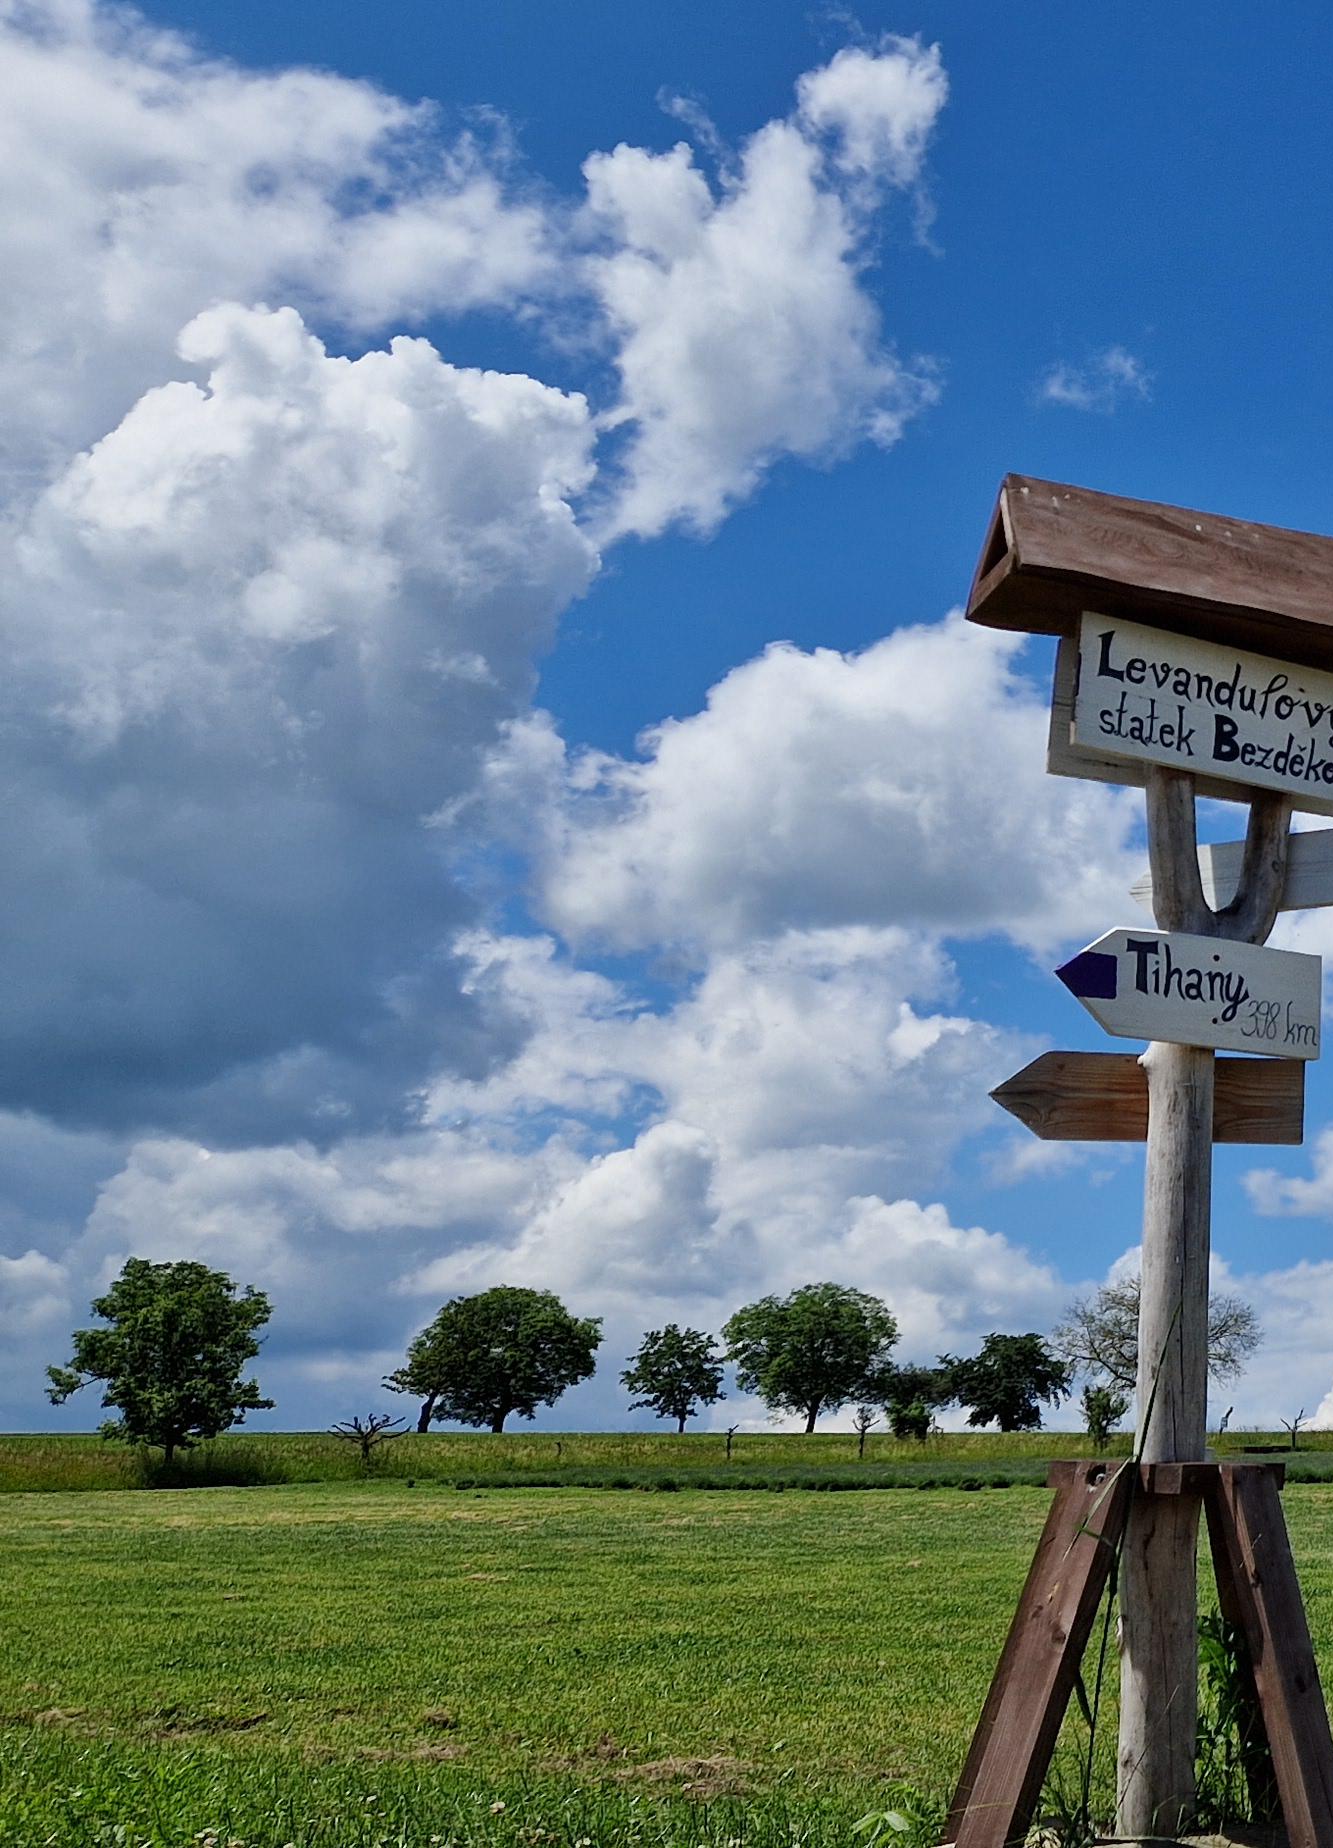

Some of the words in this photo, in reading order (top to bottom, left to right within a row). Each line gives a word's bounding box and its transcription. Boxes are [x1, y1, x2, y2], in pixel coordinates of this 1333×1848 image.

[1099, 691, 1196, 756] statek
[1126, 938, 1250, 1022] Tihany
[1240, 1000, 1281, 1039] 398
[1283, 1001, 1318, 1046] km
